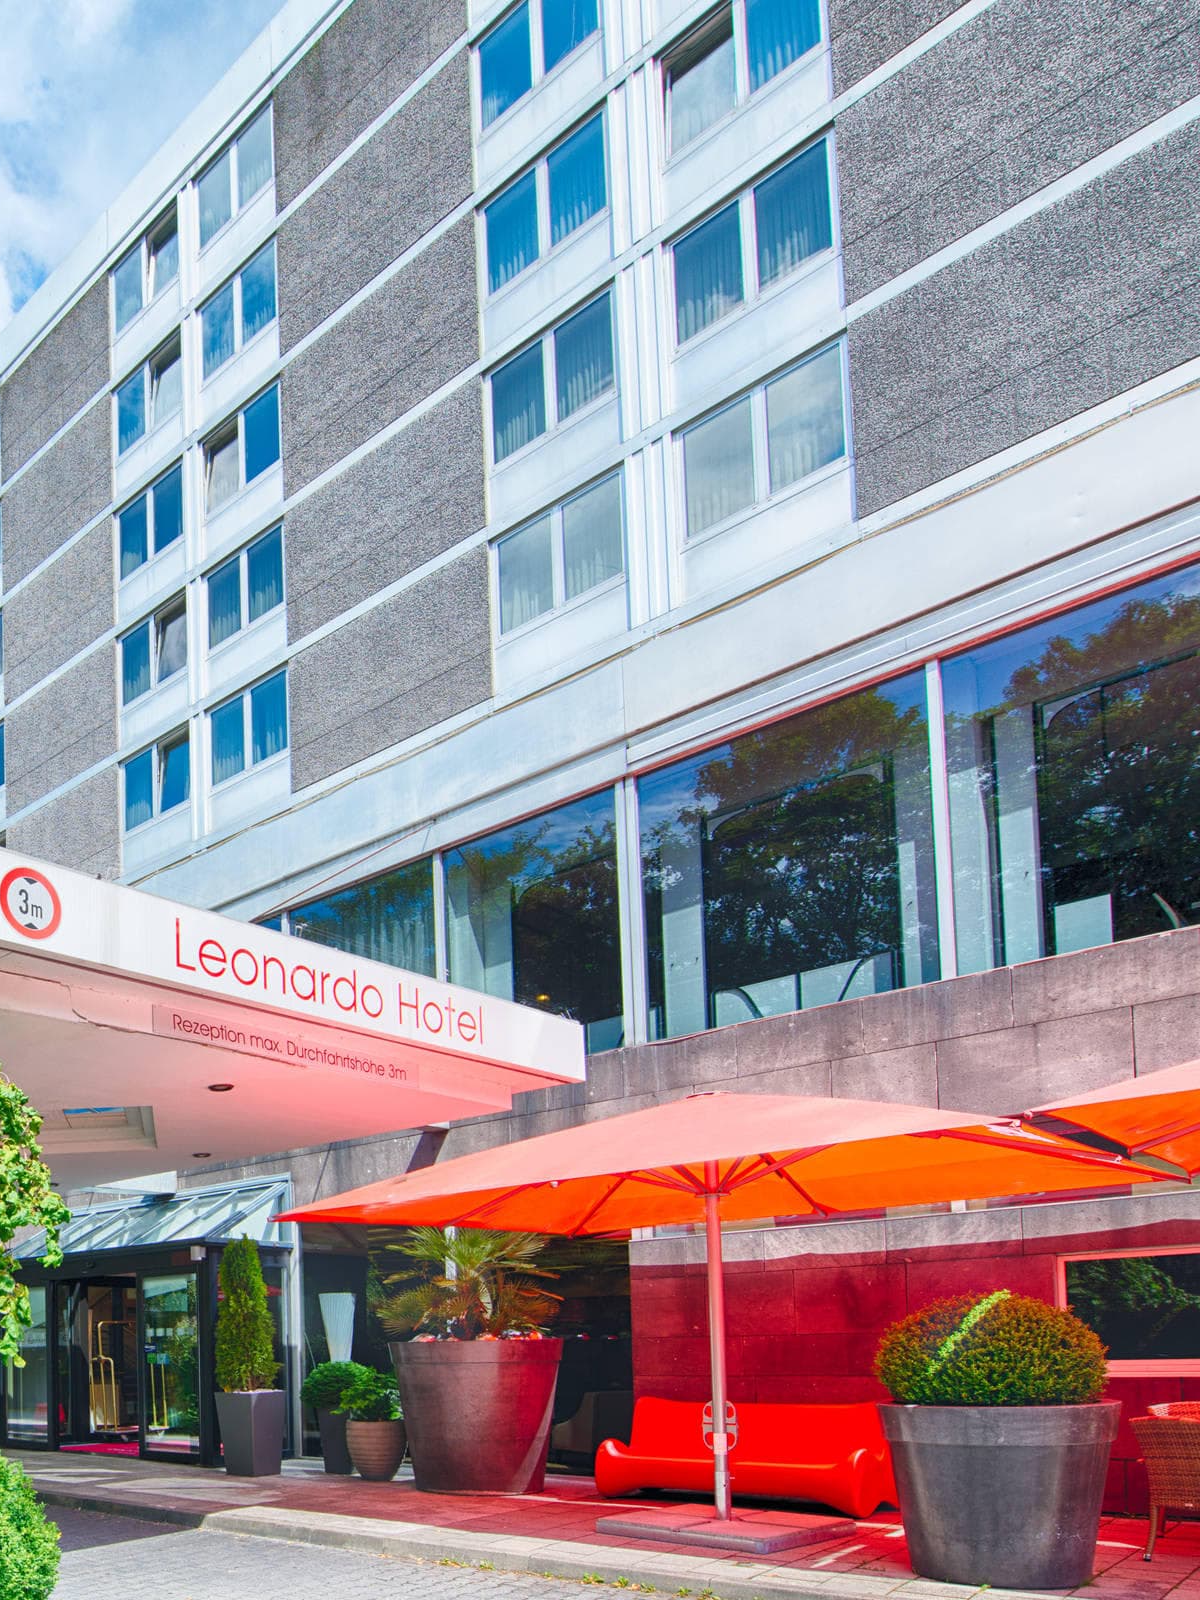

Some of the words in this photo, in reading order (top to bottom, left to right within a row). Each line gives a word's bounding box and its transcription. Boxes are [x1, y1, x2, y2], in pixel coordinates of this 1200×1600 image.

[176, 918, 383, 1018] Leonardo
[398, 983, 483, 1044] Hotel
[173, 1014, 245, 1044] Rezeption
[250, 1035, 282, 1053] max.
[388, 1064, 407, 1080] 3m
